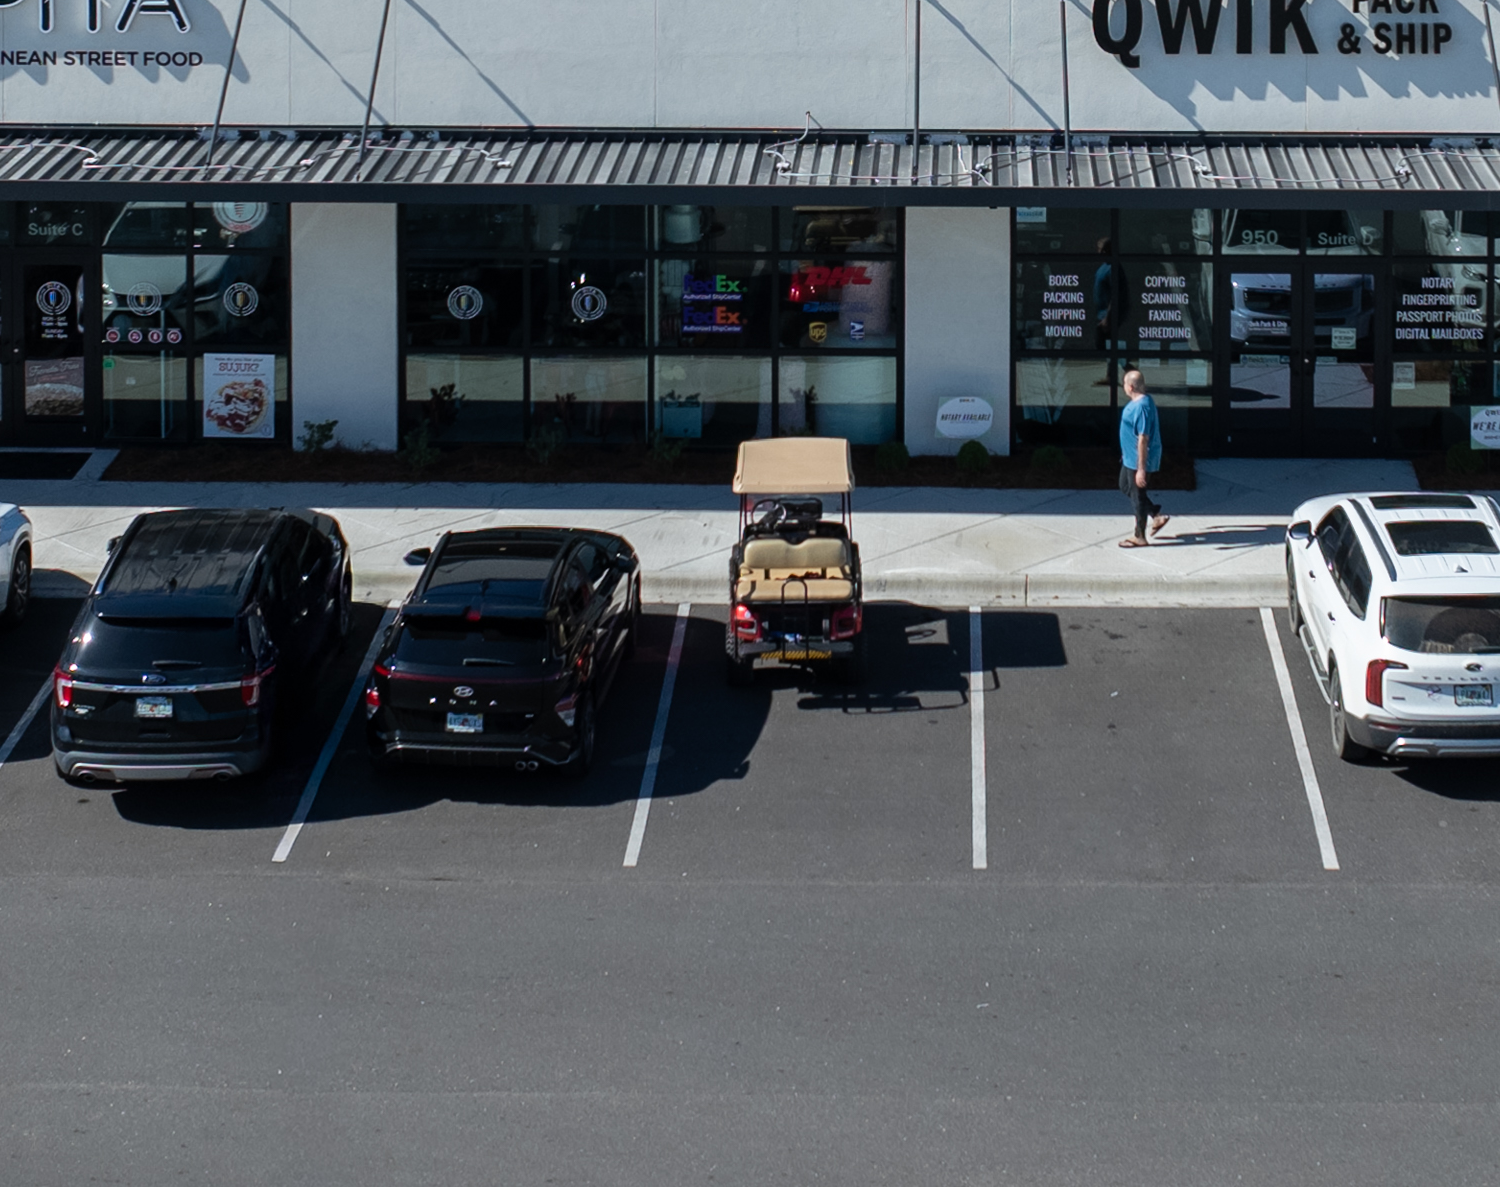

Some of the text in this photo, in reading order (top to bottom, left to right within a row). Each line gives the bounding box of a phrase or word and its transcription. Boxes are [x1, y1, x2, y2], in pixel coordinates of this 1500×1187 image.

[1337, 22, 1453, 55] & SHIP
[64, 50, 139, 66] STREET
[143, 51, 203, 67] FOOD
[28, 222, 67, 236] Suite
[71, 223, 83, 236] C
[1241, 230, 1374, 245] 950 Suite D
[804, 266, 873, 285] DHL
[1049, 275, 1079, 286] BOXES
[683, 274, 741, 292] FedEx
[1145, 276, 1186, 288] COPYING
[1421, 277, 1456, 289] NOTARY
[1043, 292, 1084, 304] PACKING
[1141, 292, 1189, 304] SCANNING
[1402, 294, 1477, 306] FINGERPRINTING
[683, 306, 741, 324] FedEx
[1041, 308, 1086, 320] SHIPPING
[1149, 310, 1182, 322] FAXING
[1396, 310, 1483, 323] PASSPORT PHOTOS
[812, 327, 826, 339] ups
[1045, 326, 1082, 338] MOVING
[1138, 326, 1192, 338] SHREDDING
[1395, 328, 1484, 340] DIGITAL MAILBOXES
[1473, 421, 1497, 430] WE'RE
